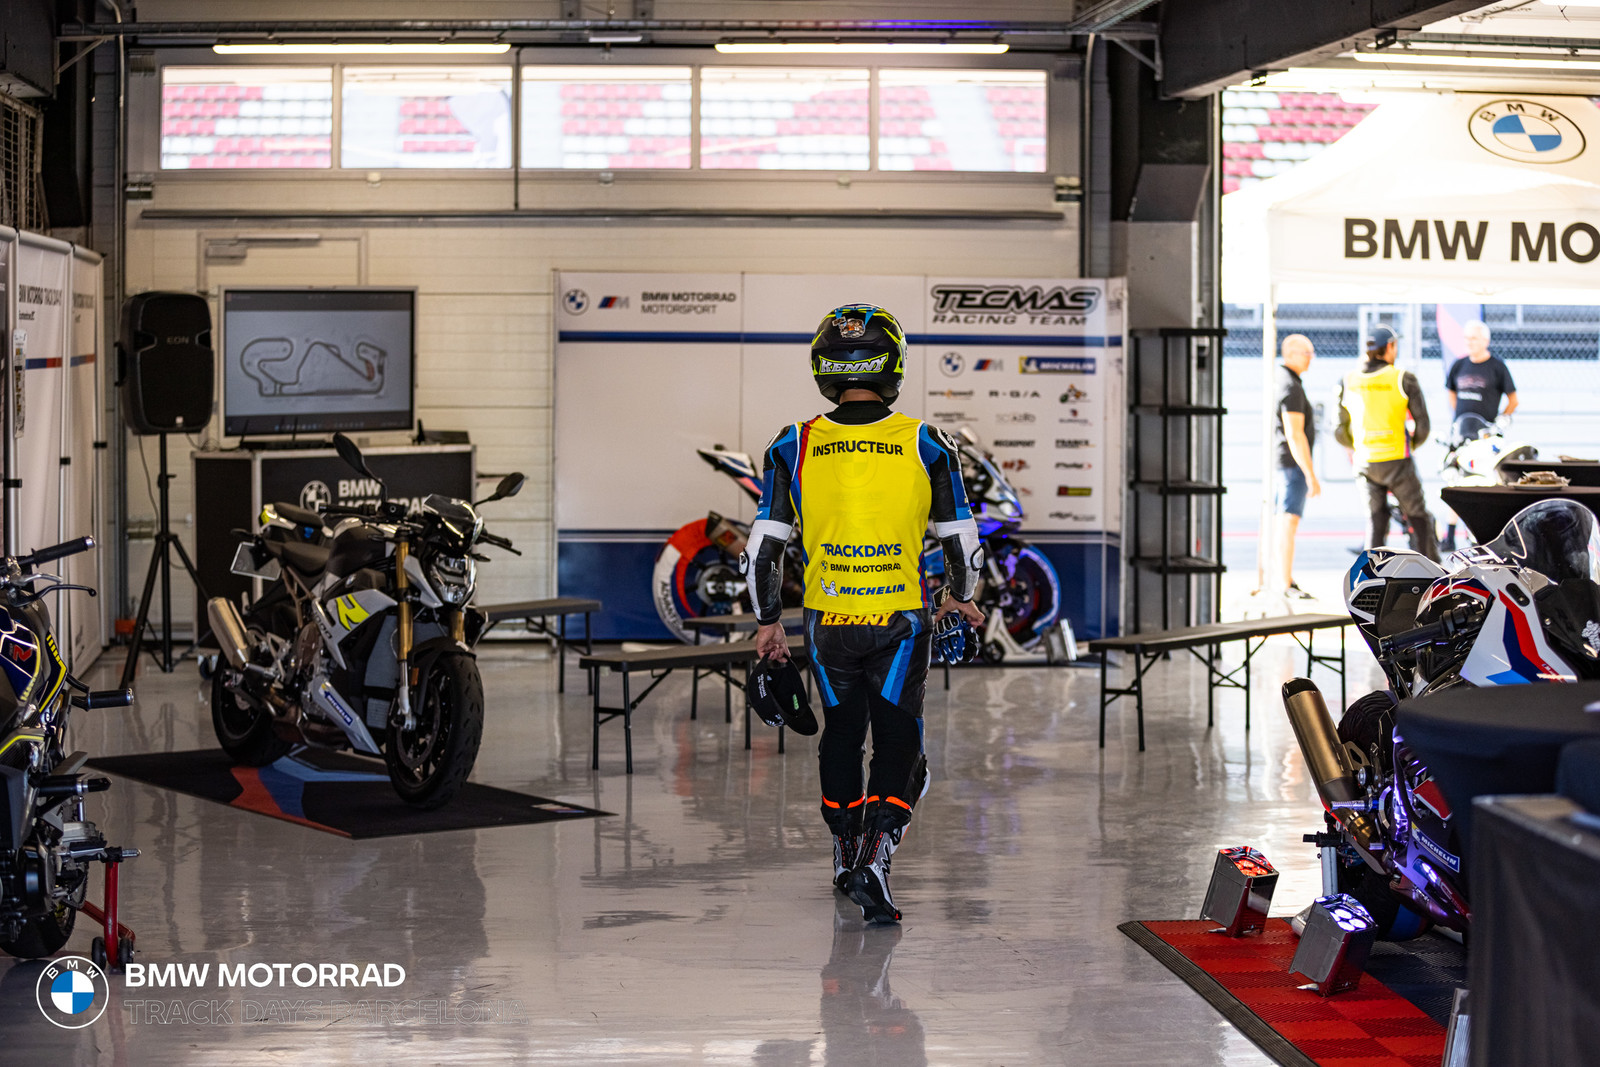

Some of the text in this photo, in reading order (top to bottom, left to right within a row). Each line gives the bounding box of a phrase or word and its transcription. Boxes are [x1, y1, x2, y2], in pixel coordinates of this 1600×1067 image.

[1344, 218, 1600, 264] BMW MO
[641, 292, 736, 302] BMW MOTORRAD
[932, 286, 1099, 314] TECMAS
[641, 304, 717, 314] MOTORSPORT
[932, 315, 1087, 326] RACING TEAM
[820, 356, 888, 373] KENNY
[812, 440, 904, 457] INSTRUCTEUR
[338, 479, 382, 497] BMW
[820, 543, 902, 558] TRACKDAYS
[830, 563, 850, 572] BMW
[839, 584, 905, 596] MICHELIN
[820, 610, 895, 626] KENNY
[1421, 836, 1457, 866] MICHELIN
